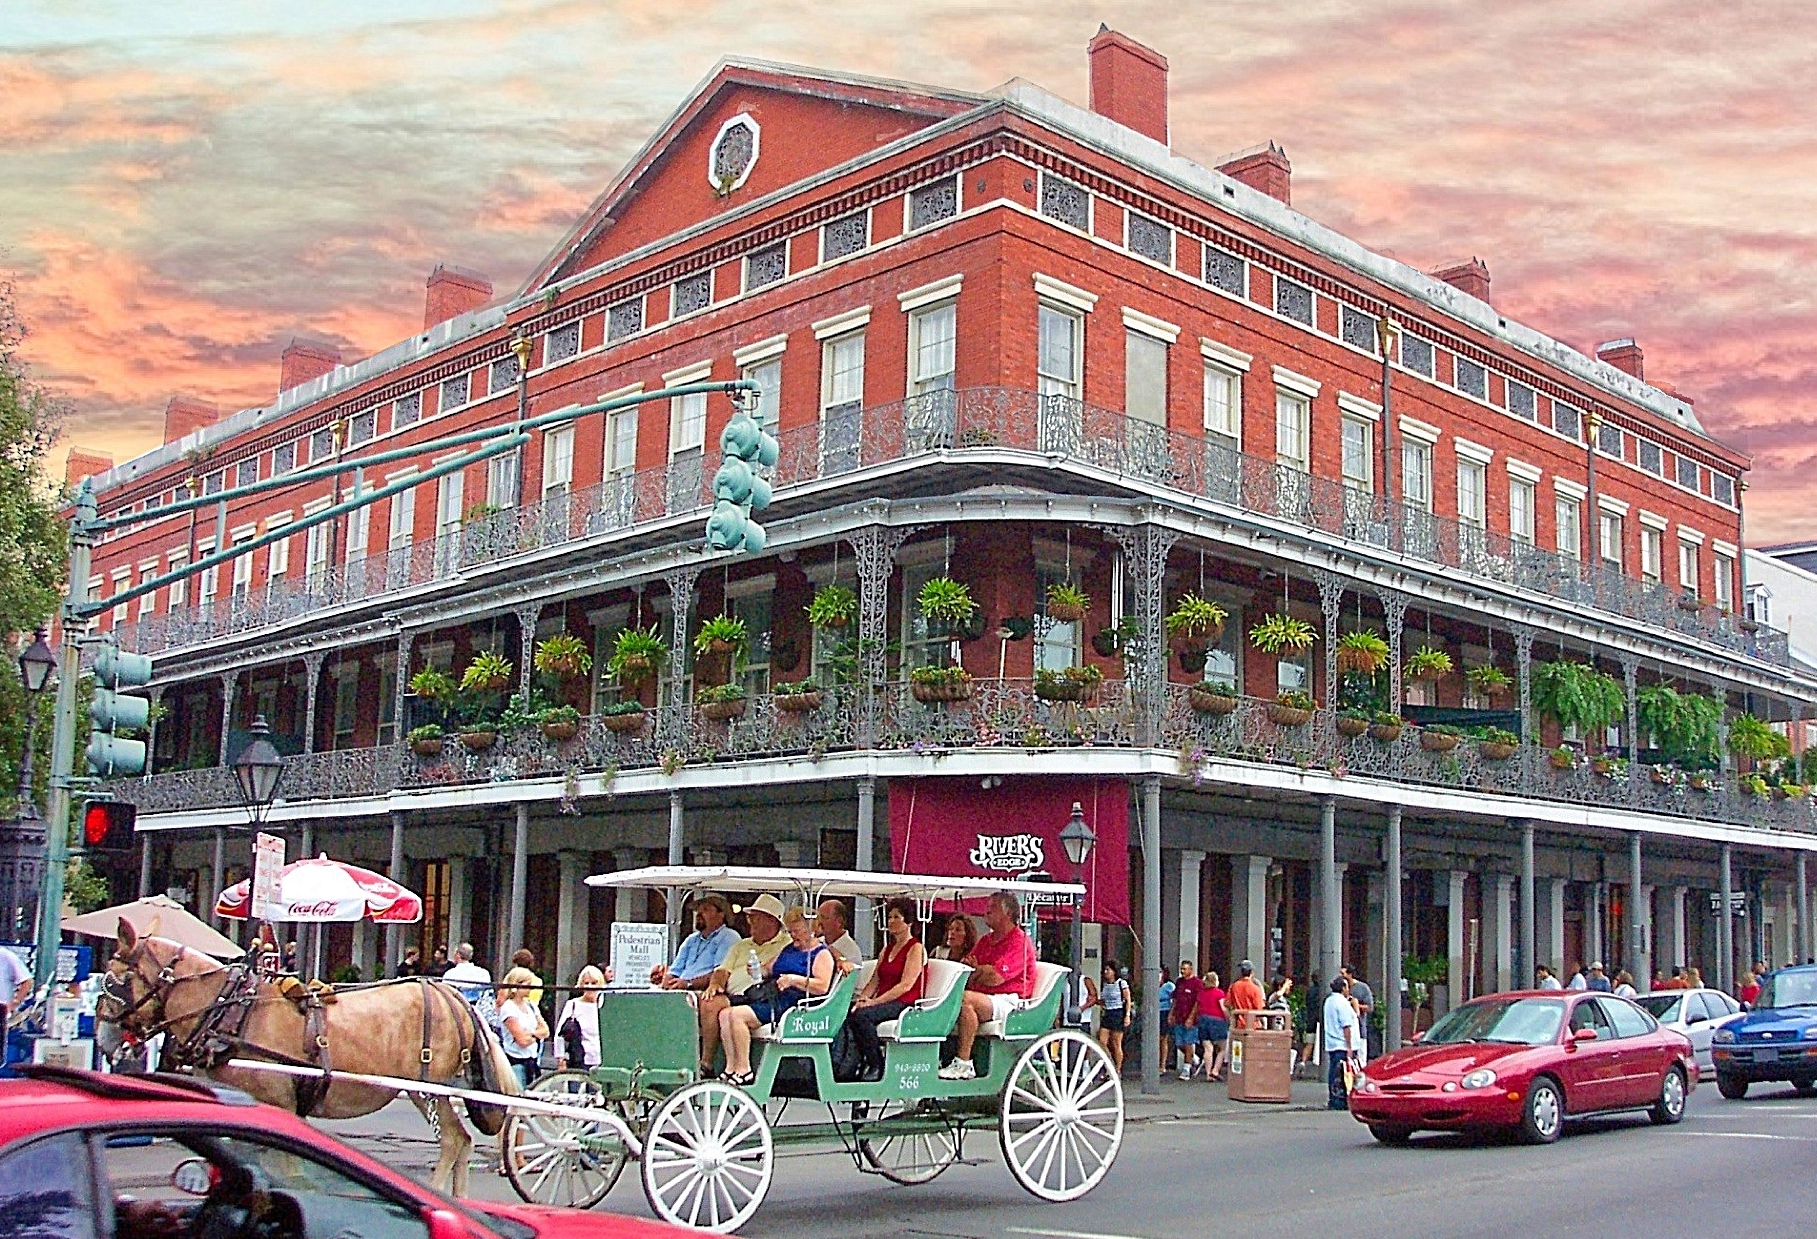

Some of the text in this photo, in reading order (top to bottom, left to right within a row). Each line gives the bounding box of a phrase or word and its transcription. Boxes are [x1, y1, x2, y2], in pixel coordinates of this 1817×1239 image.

[970, 834, 1044, 869] RIVER'S
[996, 858, 1021, 867] EDGE
[618, 934, 661, 945] Pedestrian
[630, 945, 649, 954] Mall
[792, 1015, 829, 1036] Royal
[899, 1076, 920, 1089] 566
